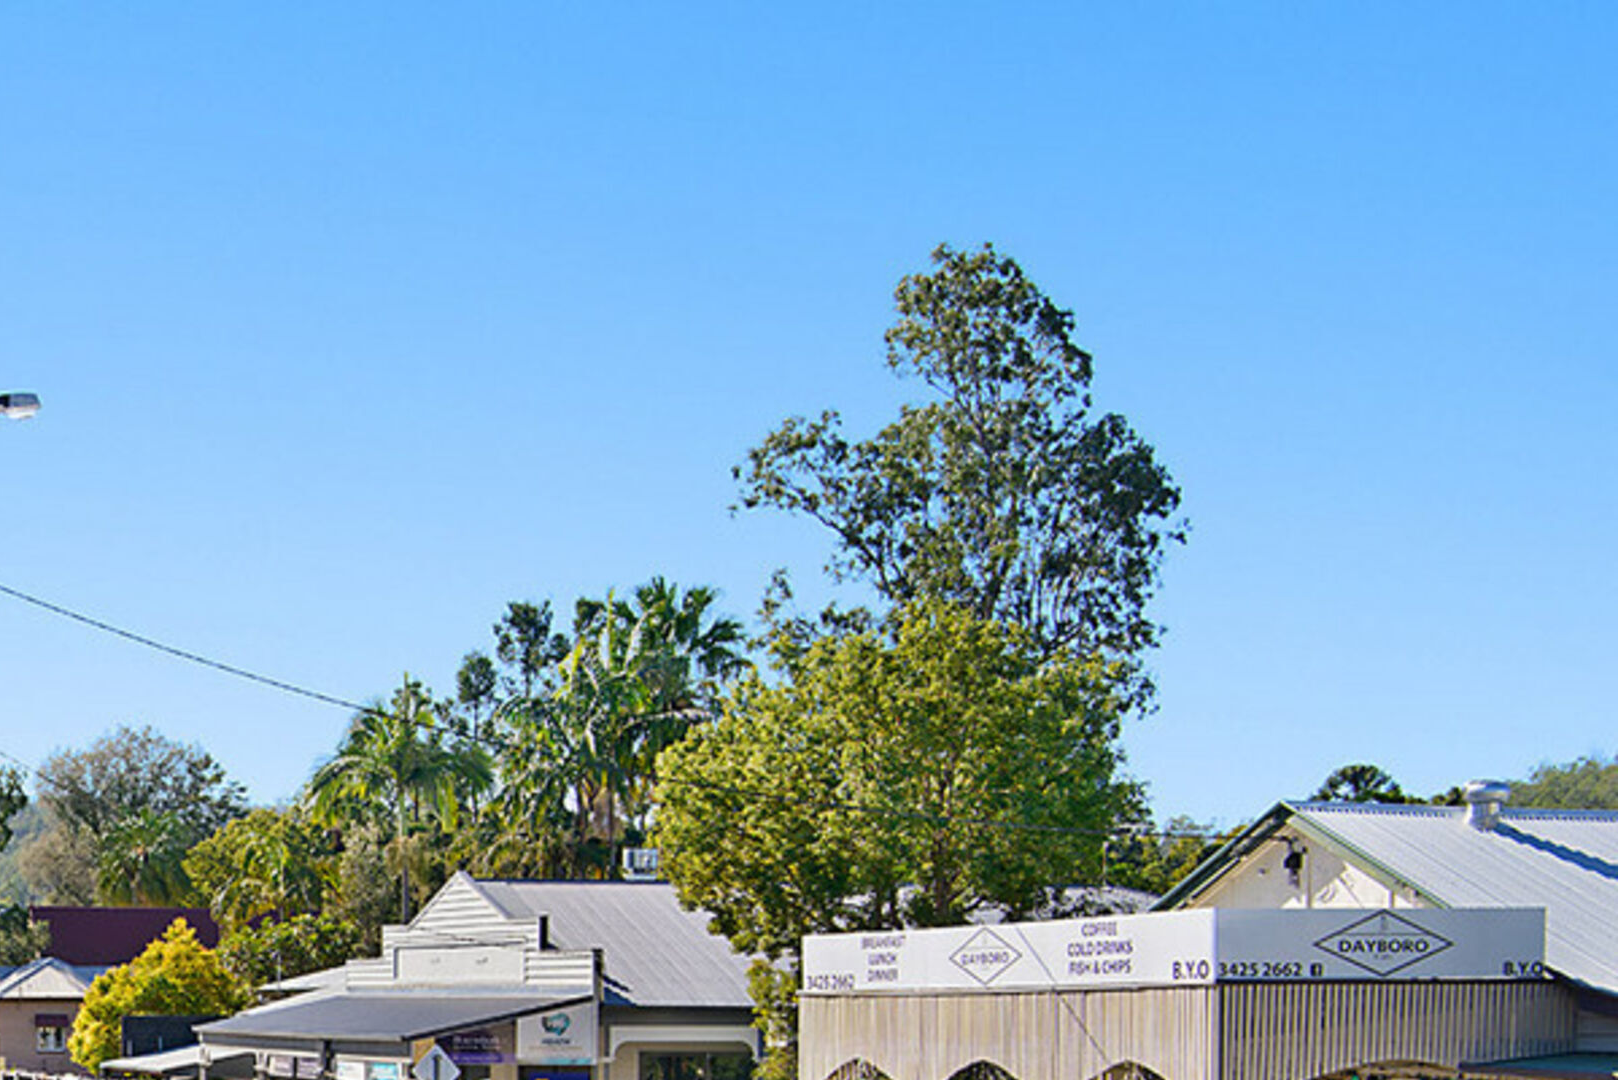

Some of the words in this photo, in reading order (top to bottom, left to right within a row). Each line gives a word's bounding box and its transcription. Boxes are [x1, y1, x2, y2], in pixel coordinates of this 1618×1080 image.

[1081, 922, 1117, 936] COFFEE
[1067, 943, 1093, 957] COLD
[1096, 940, 1133, 955] DRINKS
[1338, 939, 1430, 953] DAYBORO
[960, 951, 1010, 966] DAYBORO
[1069, 962, 1091, 976] FISH
[1093, 961, 1100, 975] &
[1102, 959, 1132, 974] CHIPS
[1219, 961, 1258, 977] 3425
[1263, 962, 1303, 977] 2662
